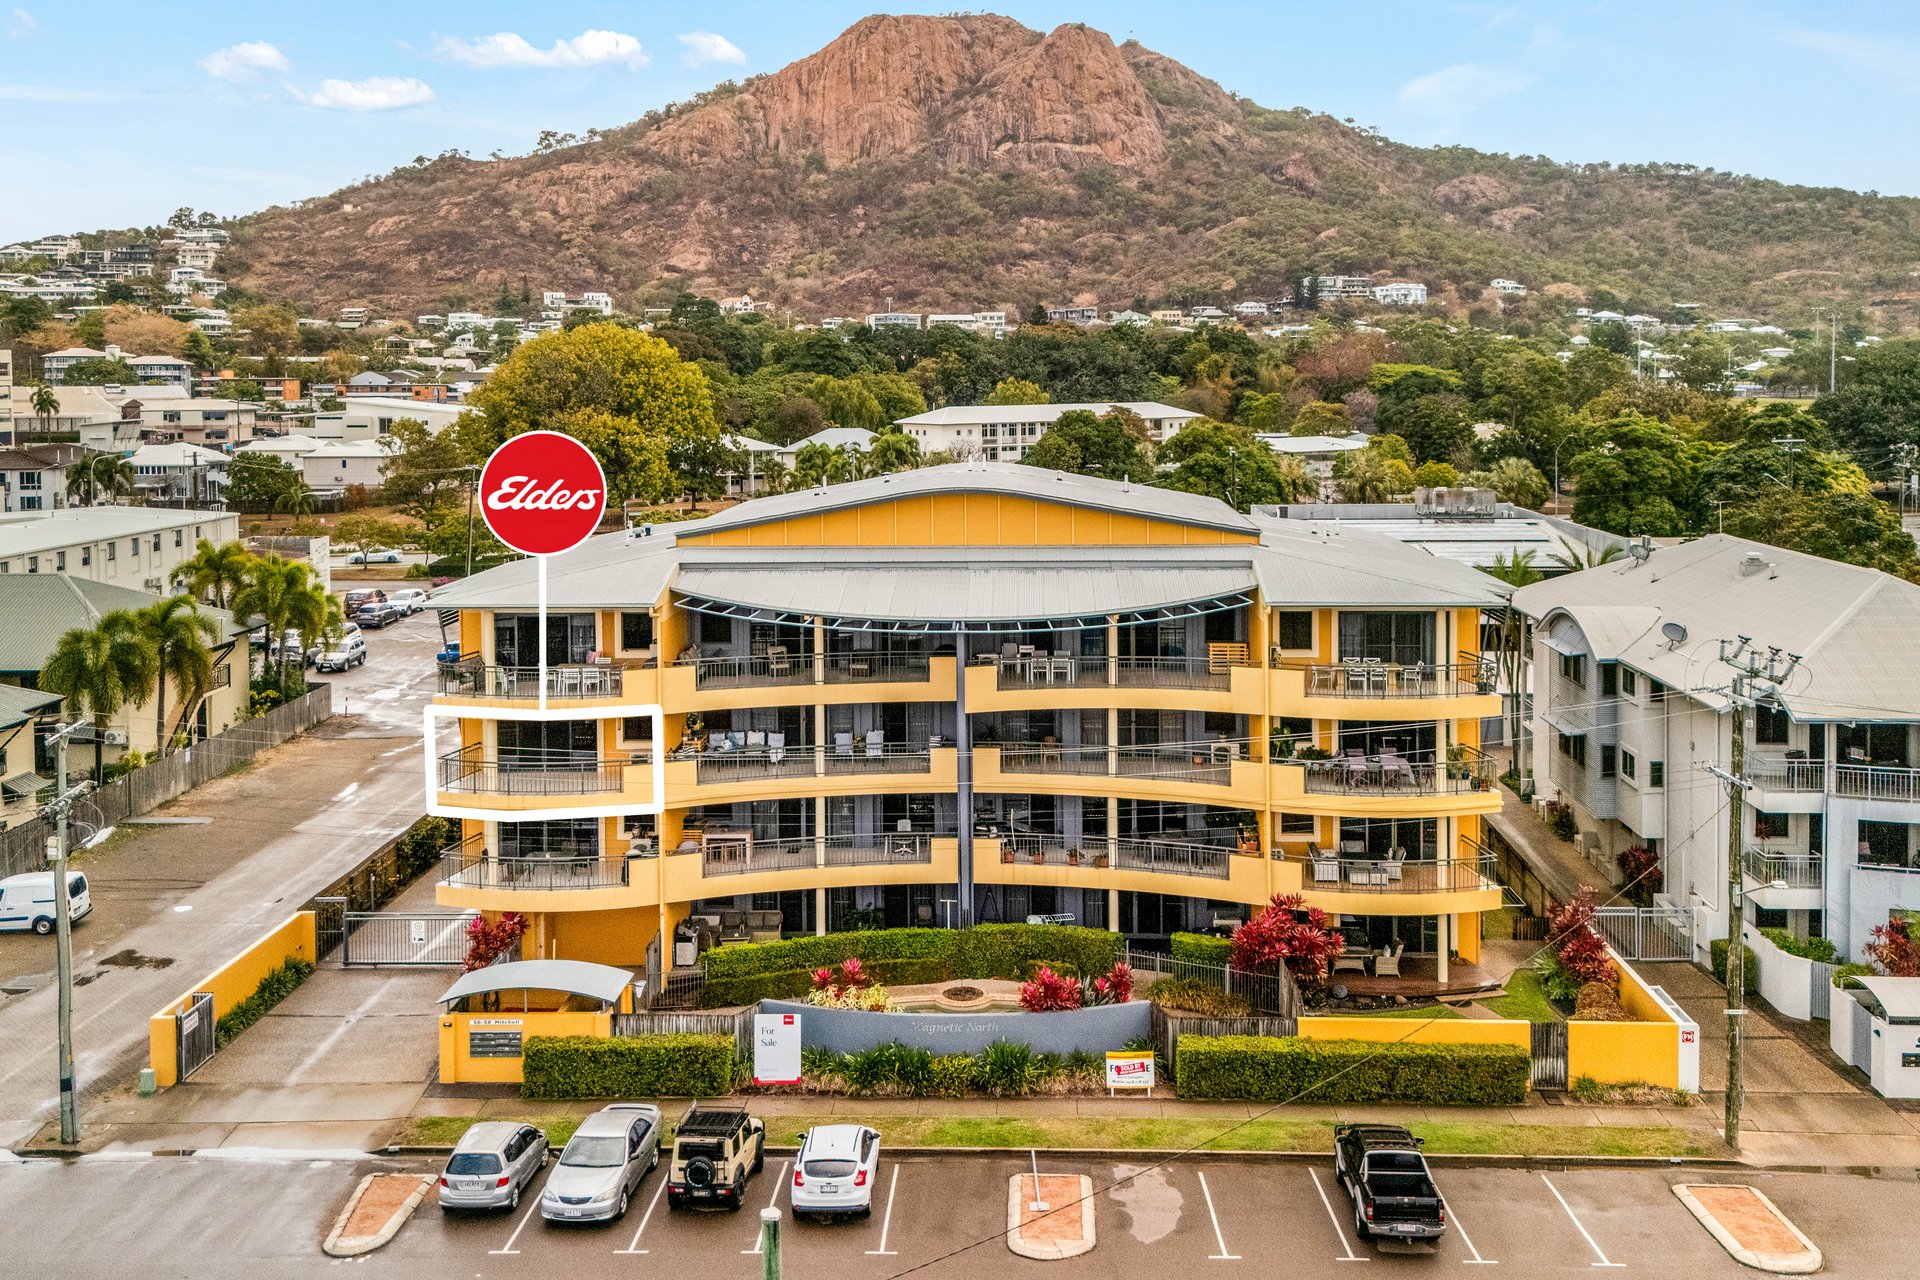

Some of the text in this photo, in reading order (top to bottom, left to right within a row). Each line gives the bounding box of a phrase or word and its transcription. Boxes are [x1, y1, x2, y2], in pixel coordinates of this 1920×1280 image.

[967, 1021, 1000, 1032] North
[761, 1027, 775, 1035] For
[761, 1039, 777, 1047] Sale
[1120, 1063, 1135, 1071] SOLD
